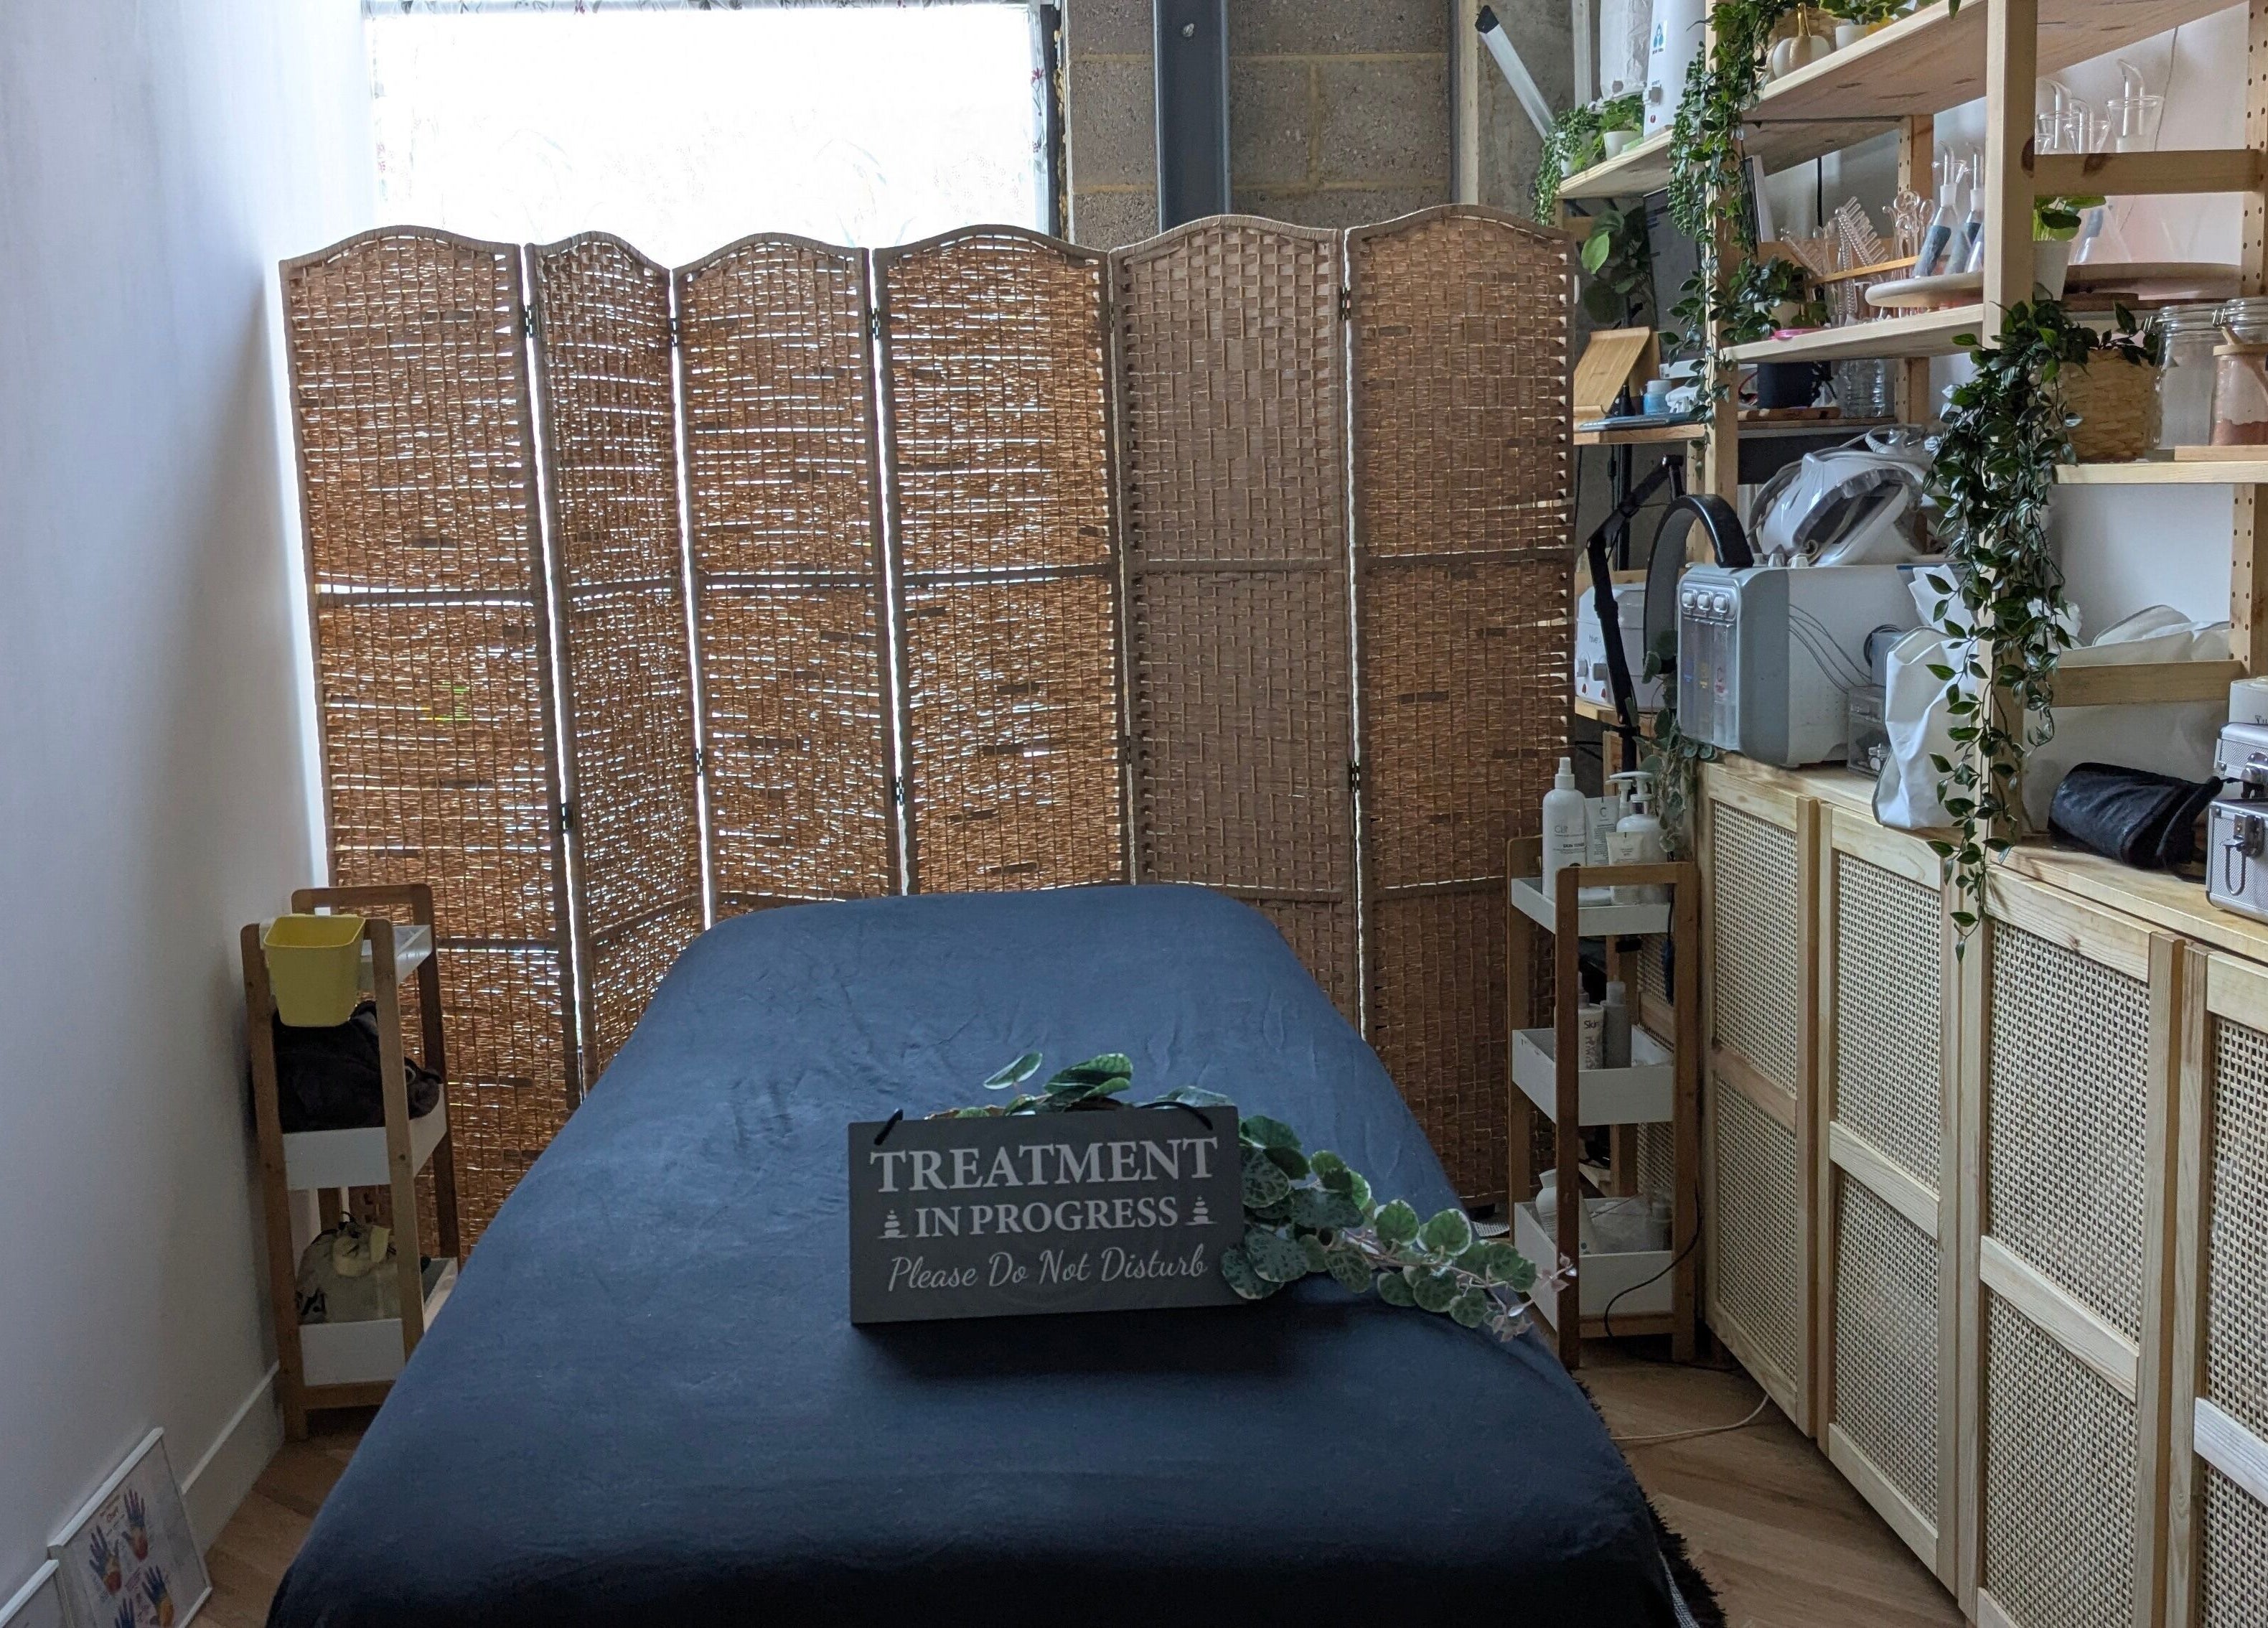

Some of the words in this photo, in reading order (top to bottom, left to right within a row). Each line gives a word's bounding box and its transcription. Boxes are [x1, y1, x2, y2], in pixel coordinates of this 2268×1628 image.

[869, 1136, 1218, 1193] TREATMENT
[914, 1206, 962, 1238] IN
[969, 1196, 1178, 1235] PROGRESS
[888, 1255, 978, 1292] Please
[988, 1251, 1028, 1287] Do
[1038, 1248, 1090, 1285] Not
[1100, 1243, 1208, 1282] Disturb
